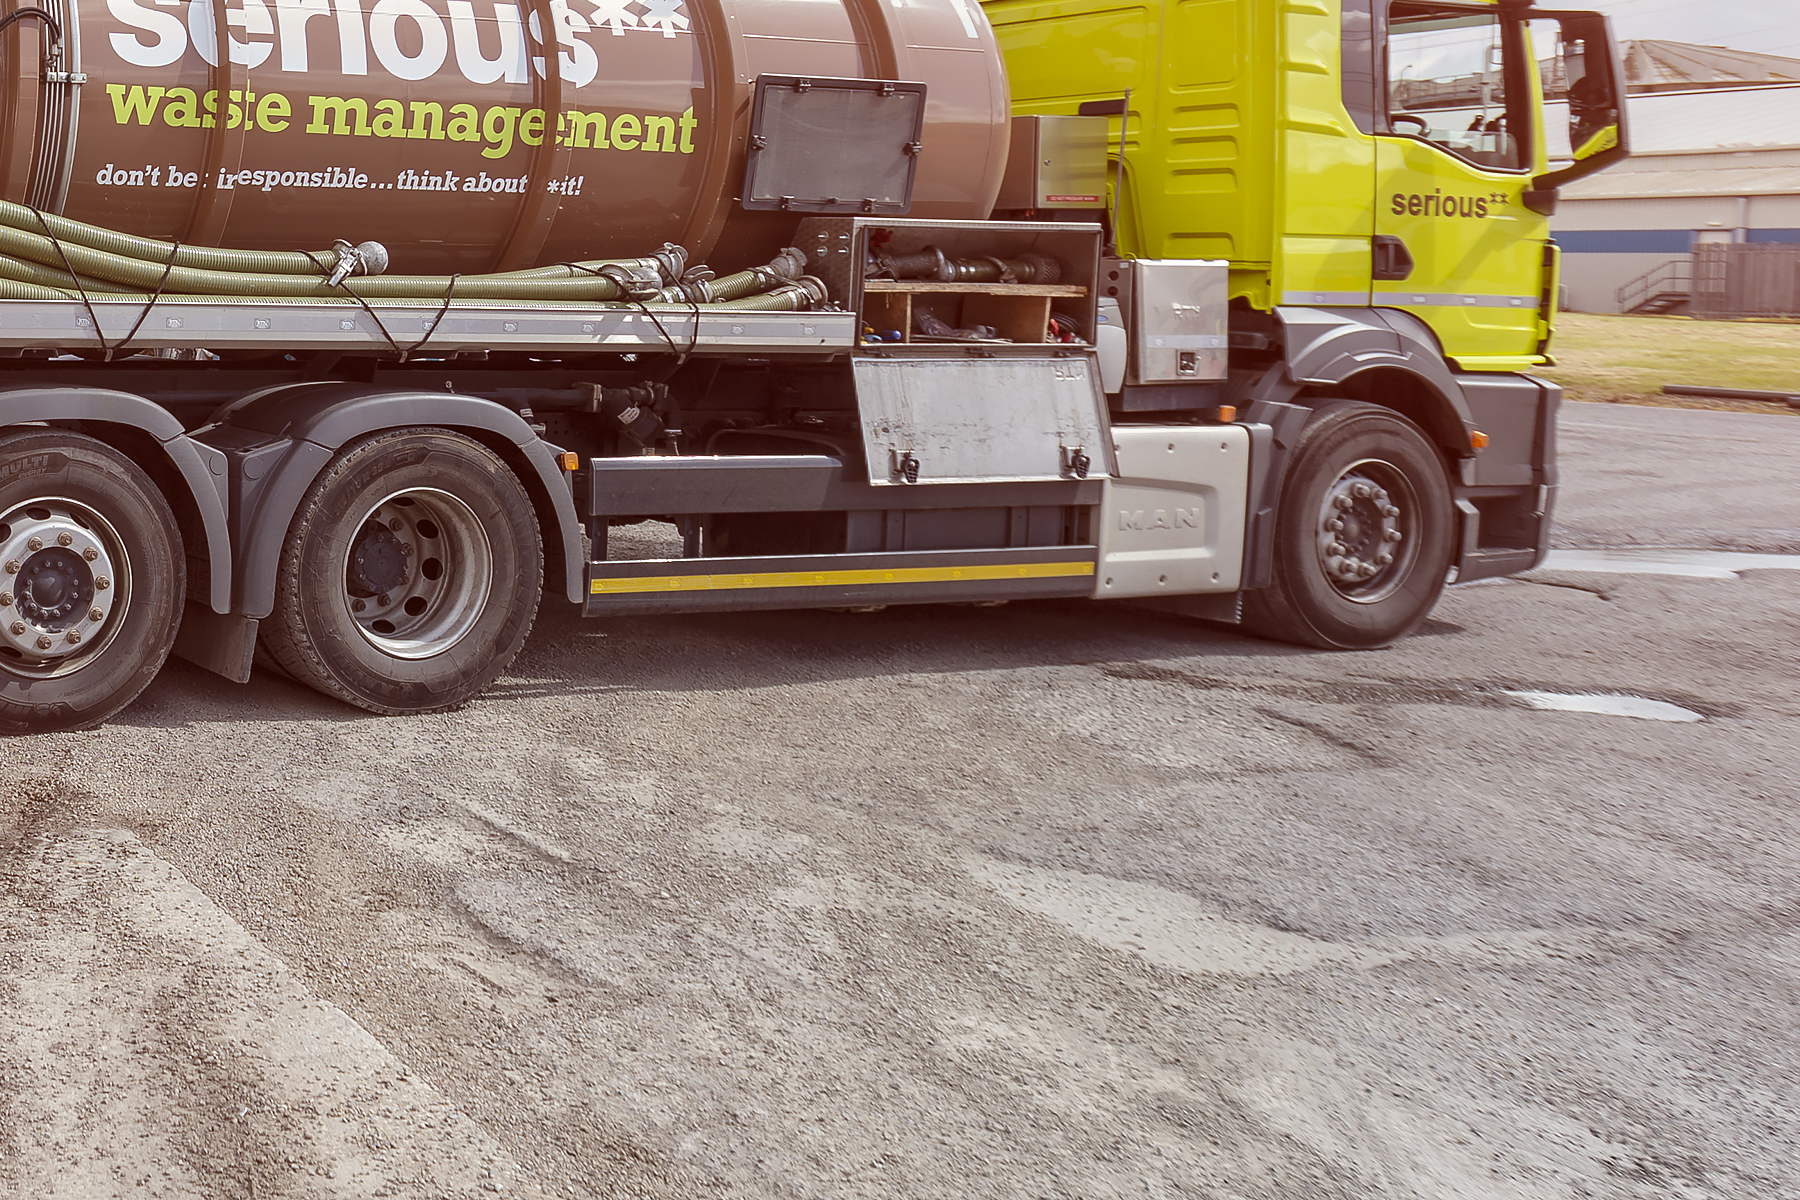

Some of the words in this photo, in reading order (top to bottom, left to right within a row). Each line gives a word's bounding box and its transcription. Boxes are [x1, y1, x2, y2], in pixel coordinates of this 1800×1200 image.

[105, 77, 292, 134] waste
[305, 95, 698, 159] management
[165, 166, 198, 188] be
[396, 169, 460, 192] think
[462, 171, 528, 193] about
[1118, 507, 1200, 532] MAN
